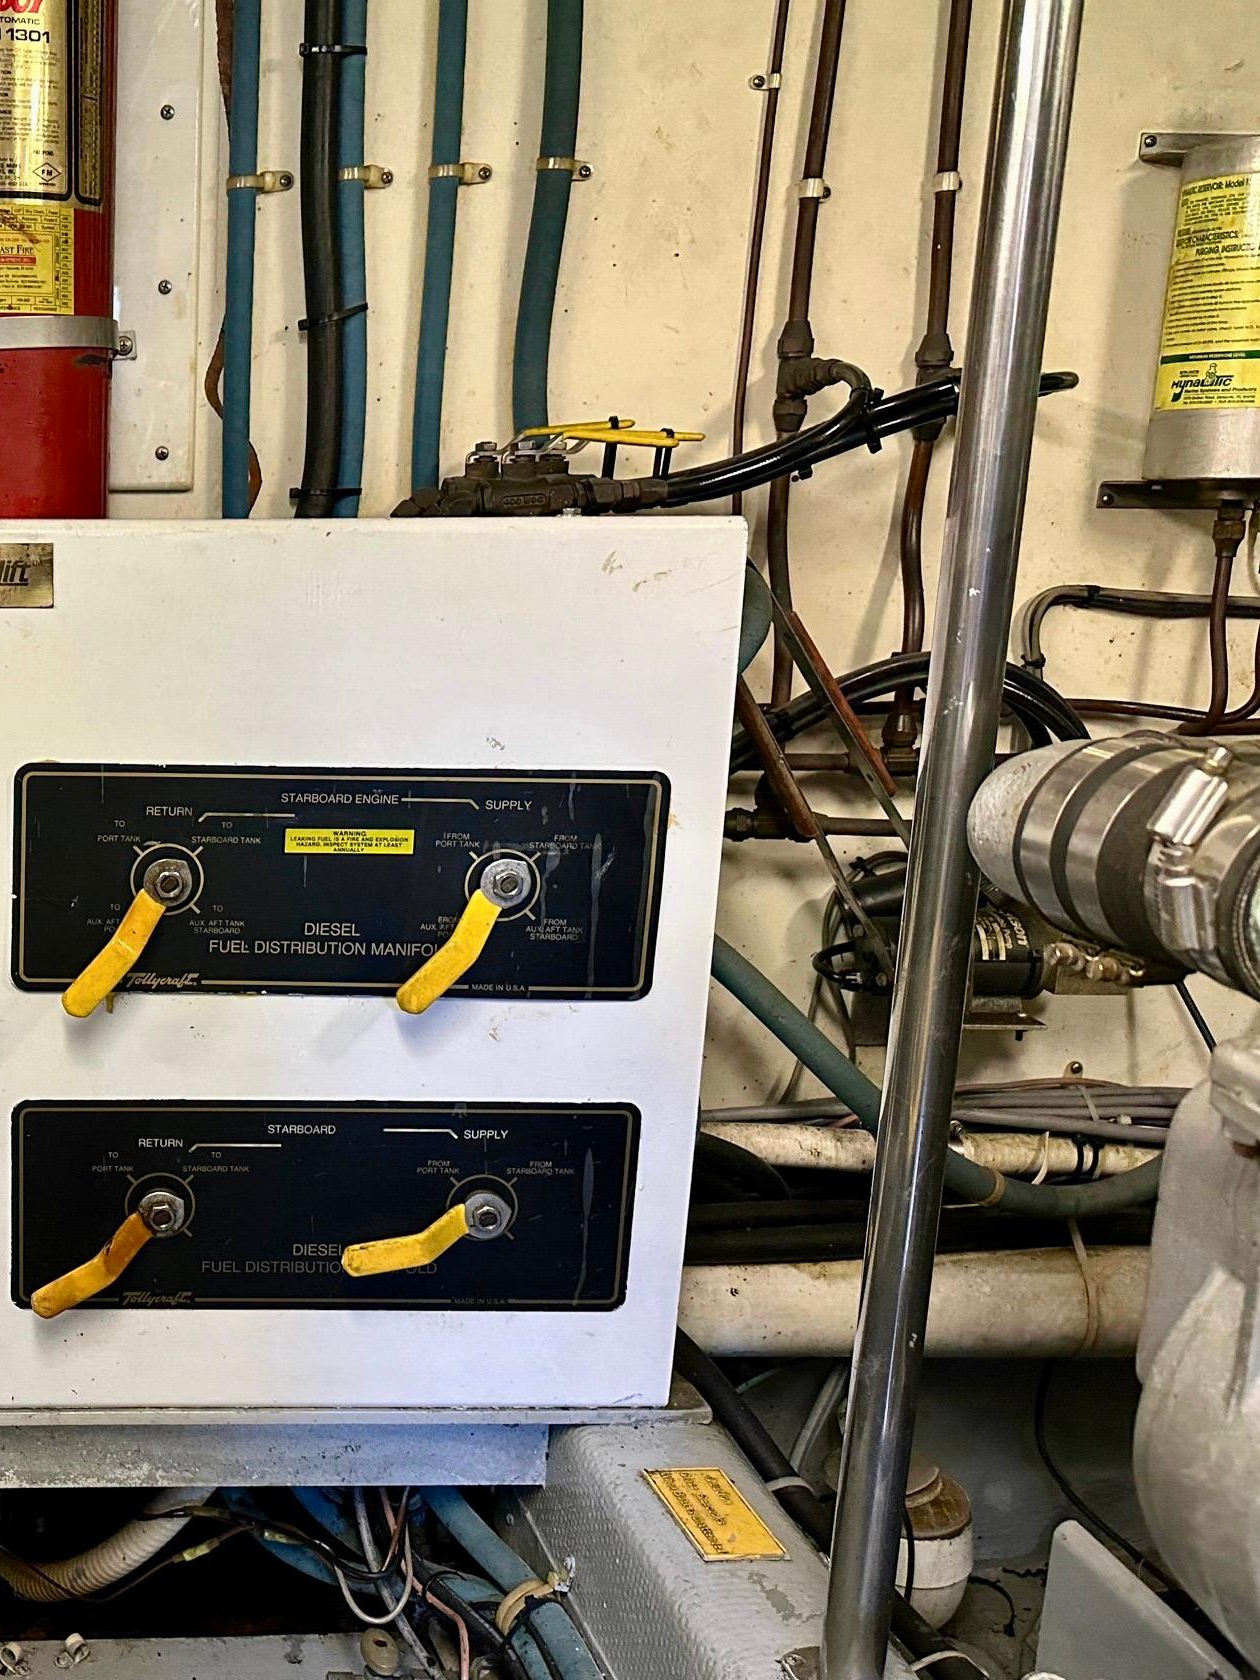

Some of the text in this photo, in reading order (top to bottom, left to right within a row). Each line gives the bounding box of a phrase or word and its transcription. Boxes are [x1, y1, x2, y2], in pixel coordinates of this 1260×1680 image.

[6, 28, 50, 43] 1301
[1225, 178, 1245, 189] Model
[281, 792, 399, 805] STARBOARD ENGINE
[485, 800, 532, 811] SUPPLY
[146, 806, 193, 817] RETURN
[114, 820, 126, 828] TO
[221, 821, 233, 829] TO
[97, 834, 141, 843] PORT TANK
[446, 832, 470, 840] FROM
[553, 834, 578, 842] FROM
[191, 836, 261, 845] STARBOARD TANK
[435, 840, 480, 848] PORT TANK
[529, 841, 578, 850] STARBOARD
[110, 903, 121, 911] TO
[86, 918, 102, 926] AUX
[189, 919, 245, 928] AUX AFT TANK
[543, 918, 567, 926] FROM
[304, 922, 360, 936] DIESEL
[420, 923, 437, 931] AUX
[545, 926, 561, 934] AFT
[562, 926, 584, 934] TANK
[529, 933, 579, 941] STARBOARD
[209, 940, 249, 954] FUEL
[255, 941, 366, 956] DISTRIBUTION
[126, 972, 199, 989] Tollycraft
[267, 1124, 337, 1135] STARBOARD
[463, 1129, 509, 1140] SUPPLY
[138, 1138, 184, 1148] RETURN
[107, 1151, 119, 1159] TO
[211, 1151, 222, 1159] TO
[114, 1165, 134, 1173] TANK
[182, 1165, 250, 1173] STARBOARD TANK
[439, 1167, 460, 1175] TANK
[554, 1168, 575, 1176] TANK
[201, 1260, 241, 1273] FUEL
[122, 1291, 193, 1305] Tollycraft
